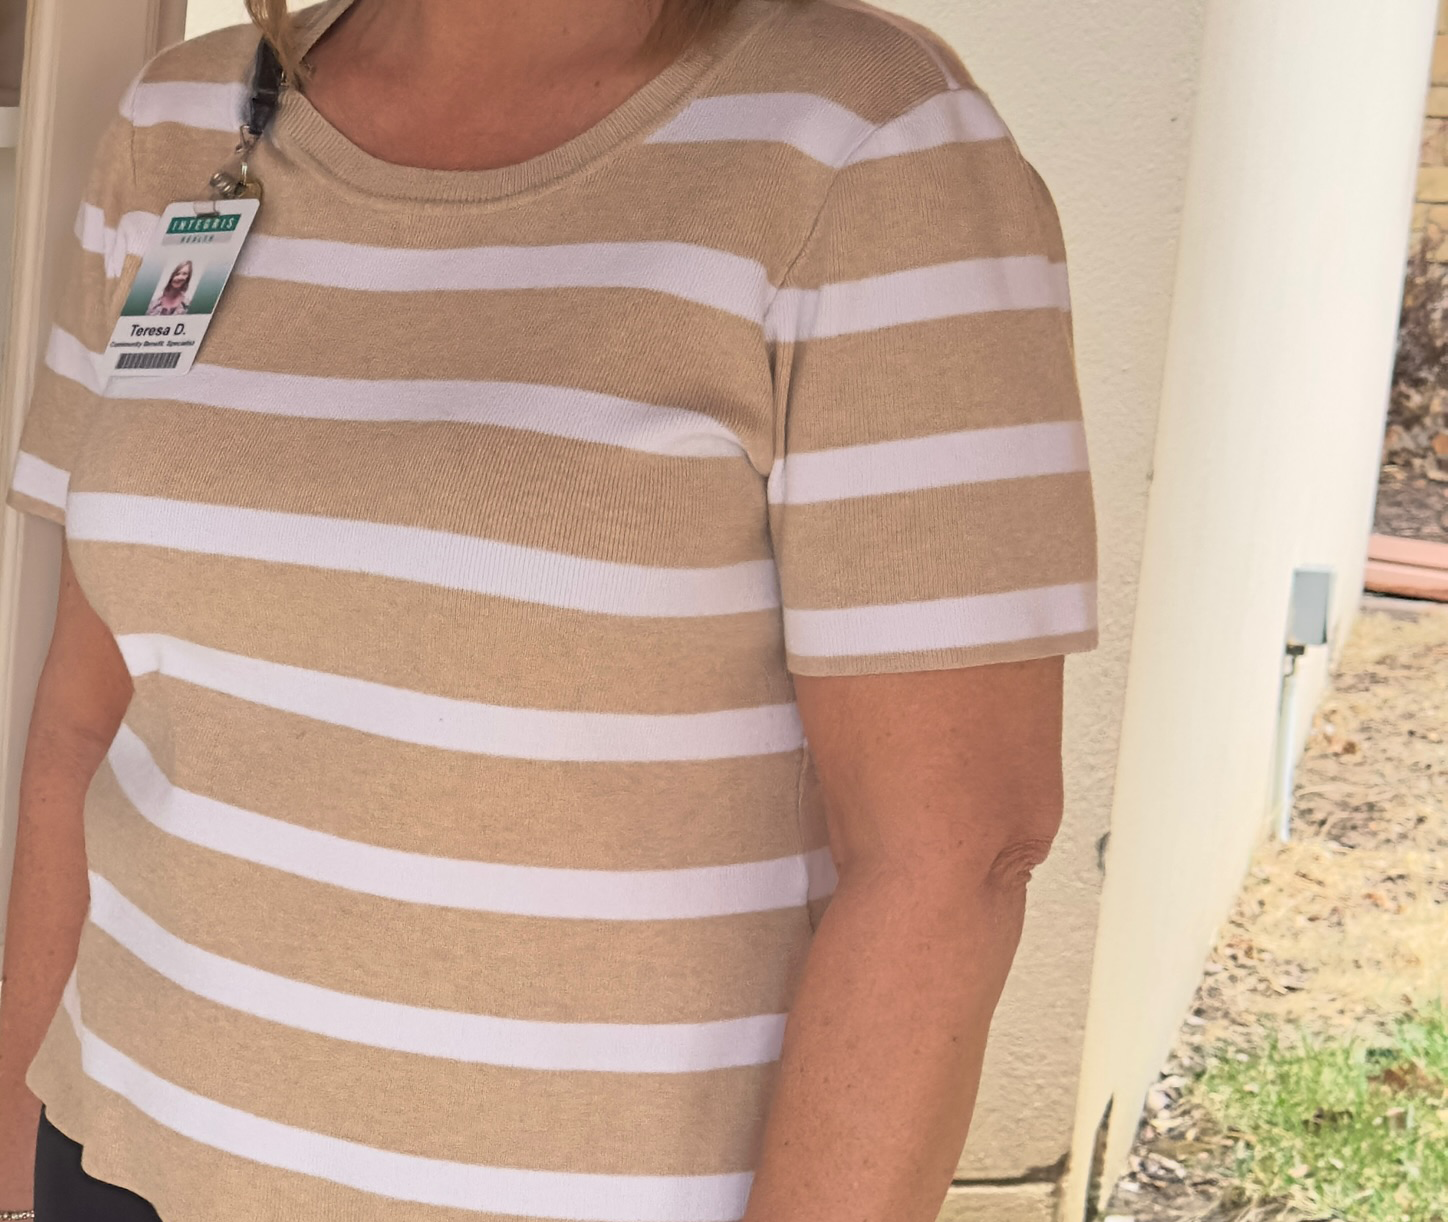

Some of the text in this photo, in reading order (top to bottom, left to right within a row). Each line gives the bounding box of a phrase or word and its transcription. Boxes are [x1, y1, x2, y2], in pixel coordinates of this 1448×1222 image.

[172, 217, 235, 231] INTEGRIS
[130, 323, 186, 337] Teresa D.
